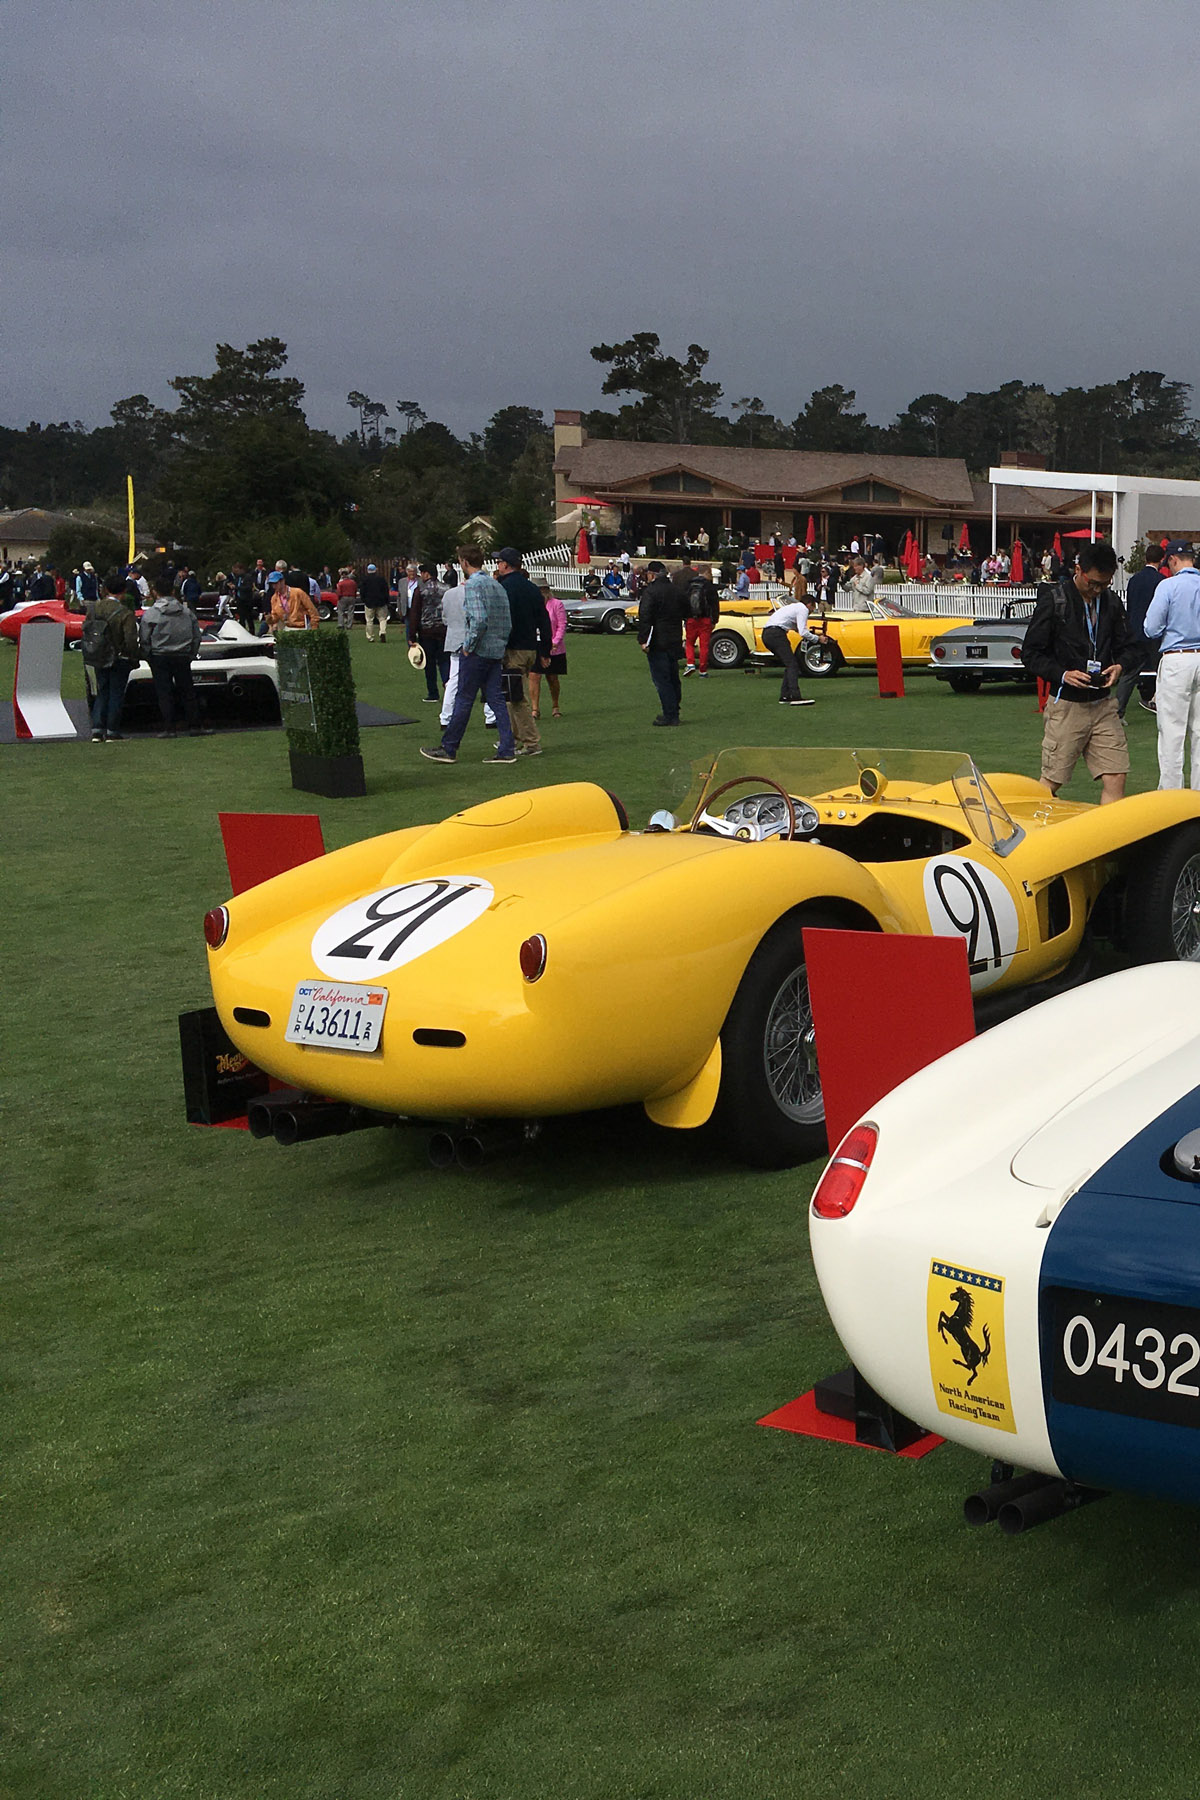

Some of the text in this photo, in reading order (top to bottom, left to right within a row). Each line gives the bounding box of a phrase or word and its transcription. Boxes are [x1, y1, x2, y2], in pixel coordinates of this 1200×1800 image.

[298, 987, 369, 1007] OCT California
[304, 1005, 362, 1040] 43611
[939, 1382, 1006, 1411] North American
